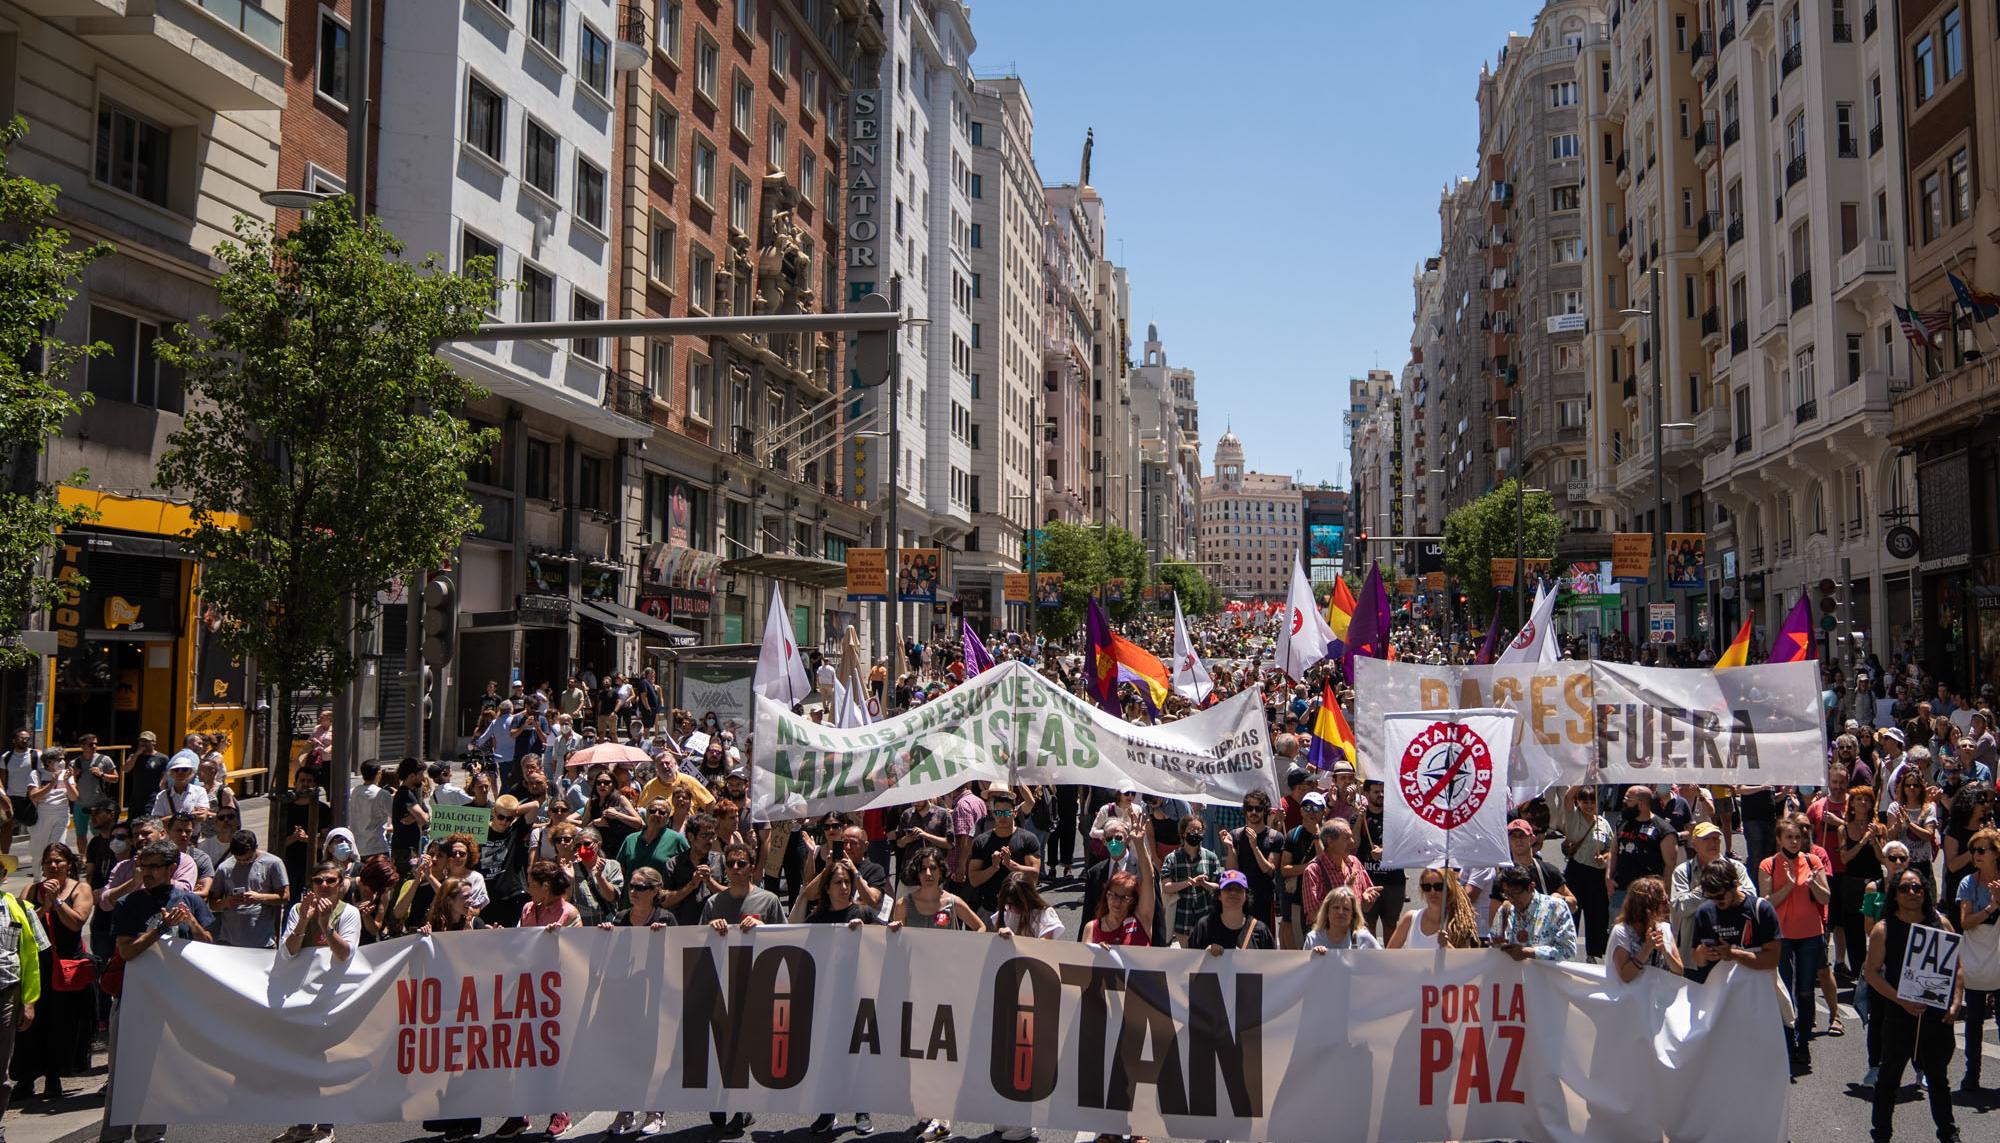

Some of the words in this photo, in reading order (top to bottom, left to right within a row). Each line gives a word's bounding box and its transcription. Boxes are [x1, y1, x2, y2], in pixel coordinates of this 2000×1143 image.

[849, 94, 877, 268] SENATOR
[1426, 543, 1443, 555] Ub
[774, 711, 1100, 805] MILITARISTAS
[1126, 749, 1147, 765] NO
[1150, 753, 1181, 772] LAS
[1185, 750, 1264, 775] PAGAMOS
[1409, 726, 1460, 757] OTAN
[1461, 731, 1486, 758] NO
[1597, 703, 1761, 770] FUERA
[434, 811, 485, 824] DIALOGUE
[1401, 769, 1447, 825] FUERA
[1452, 769, 1491, 824] BASES
[432, 822, 452, 833] FOR
[453, 824, 485, 836] PEACE.
[1905, 925, 1962, 978] PAZ
[396, 976, 442, 1026] NO
[456, 975, 480, 1023] A
[493, 970, 562, 1020] LAS
[1420, 984, 1480, 1025] POR
[1492, 983, 1527, 1024] LA
[396, 1019, 561, 1075] GUERRAS
[681, 944, 817, 1090] NO
[848, 997, 882, 1056] A
[900, 1000, 959, 1063] LA
[989, 956, 1265, 1119] OTAN
[1418, 1025, 1527, 1107] PAZ
